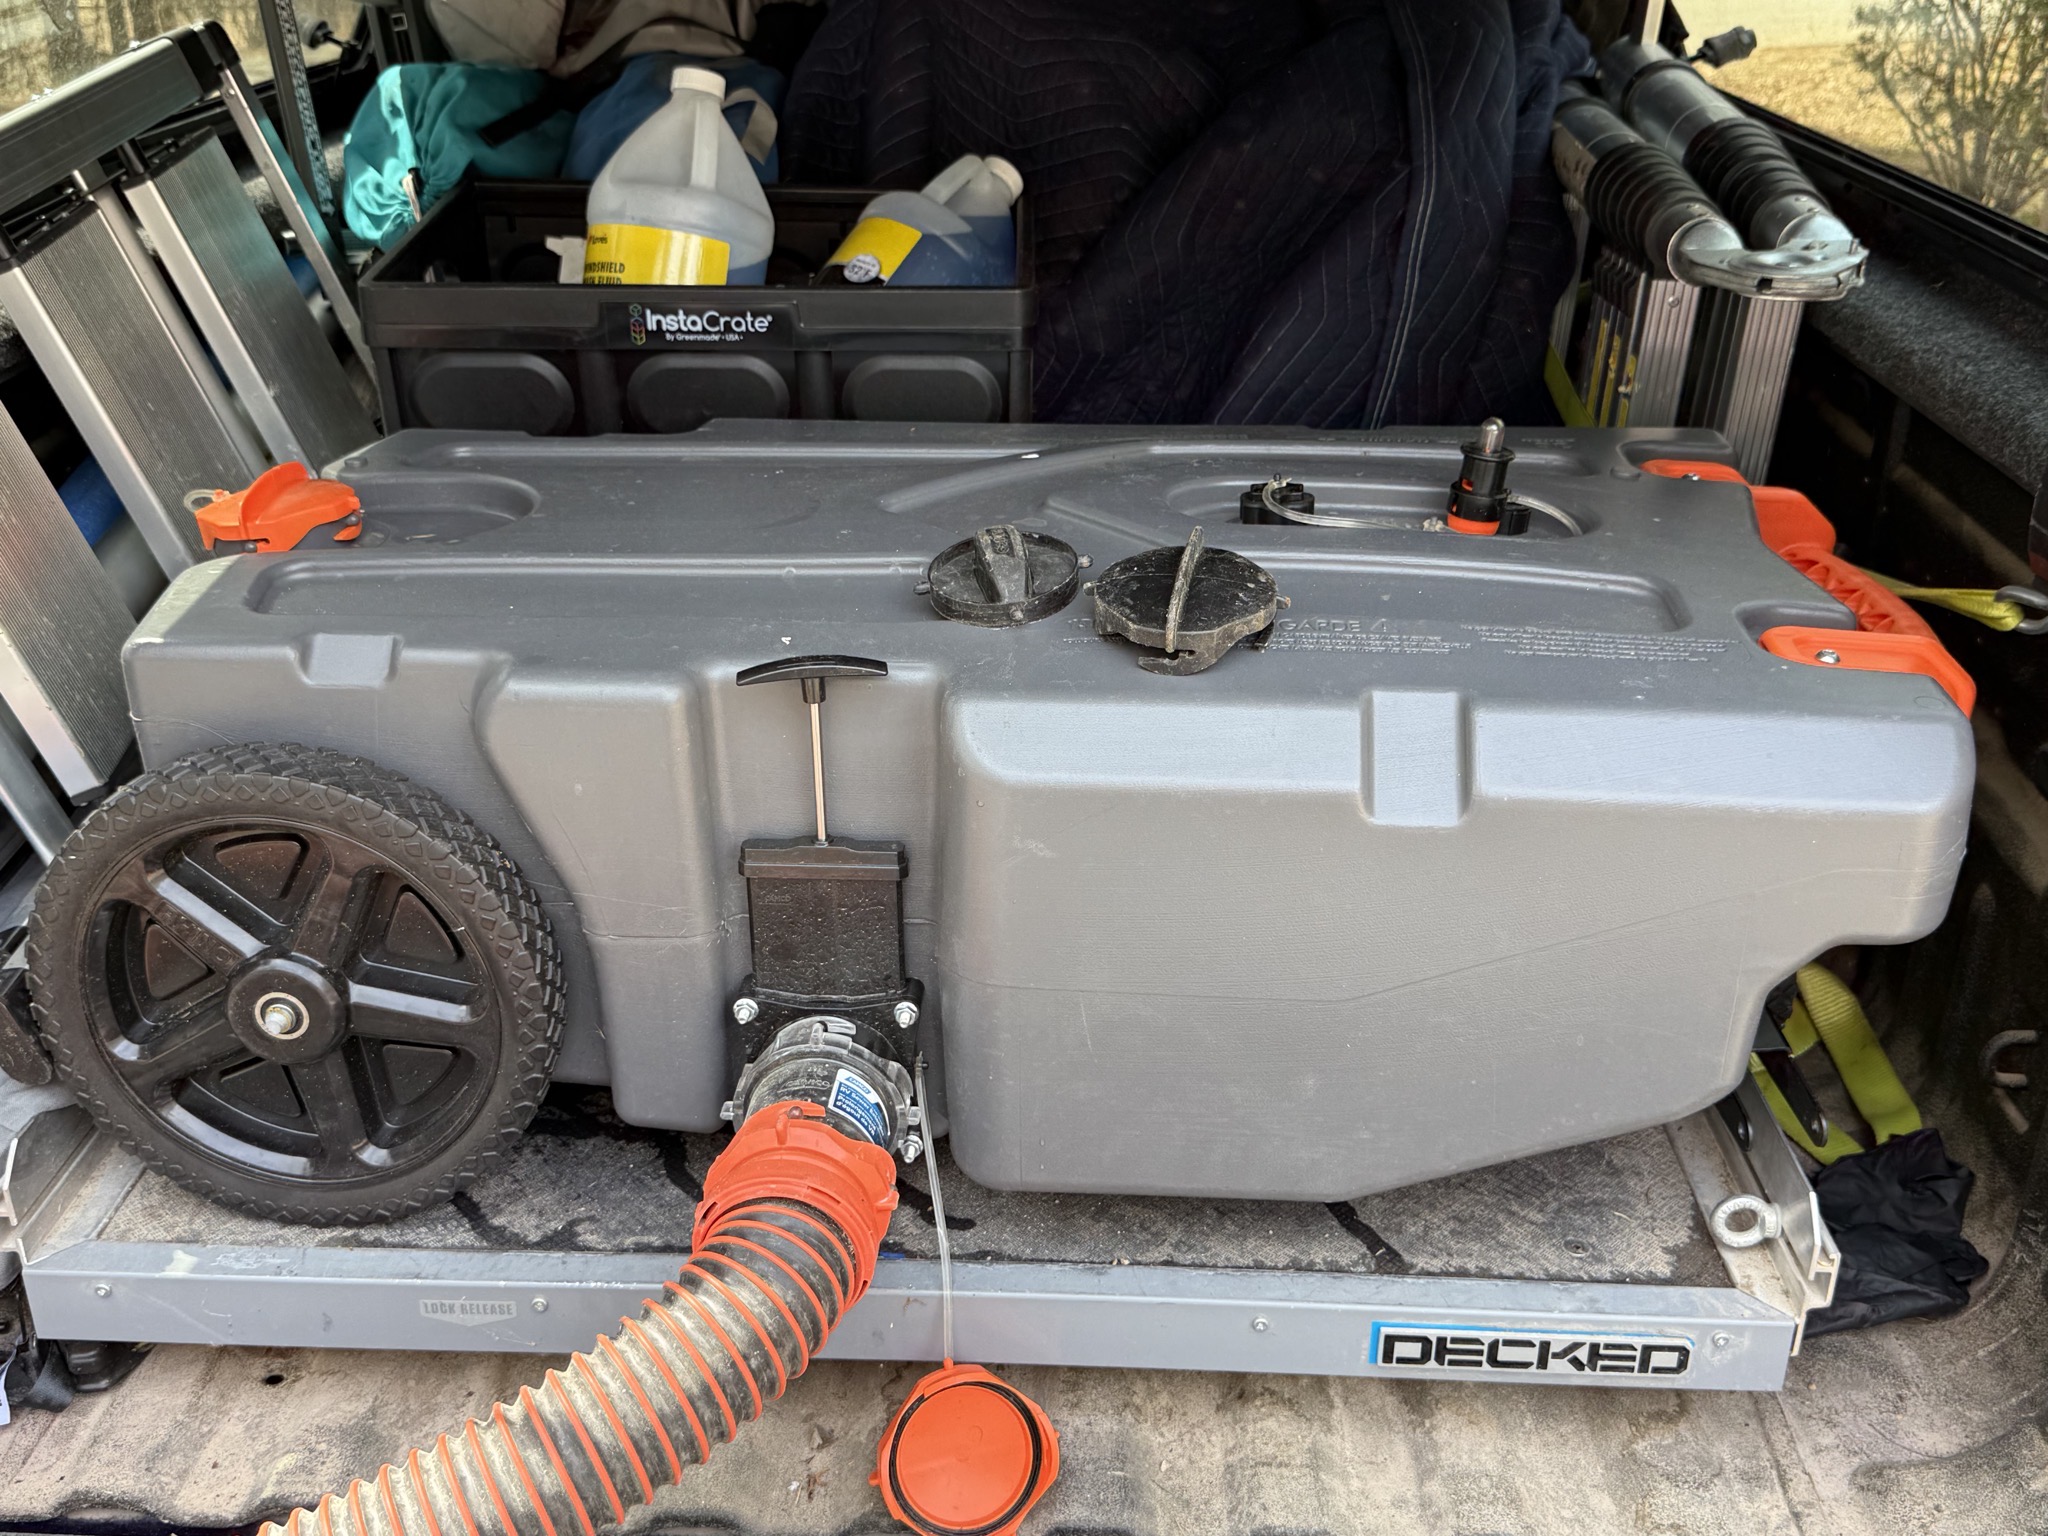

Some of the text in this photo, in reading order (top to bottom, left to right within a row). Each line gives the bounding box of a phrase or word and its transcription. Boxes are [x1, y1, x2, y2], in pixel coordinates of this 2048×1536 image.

[584, 261, 626, 274] INDSHIELD
[665, 333, 675, 342] By
[725, 333, 739, 342] USA
[840, 1085, 851, 1095] RV
[423, 1301, 514, 1316] LOCK RELEASE
[1382, 1333, 1692, 1375] DECKED
